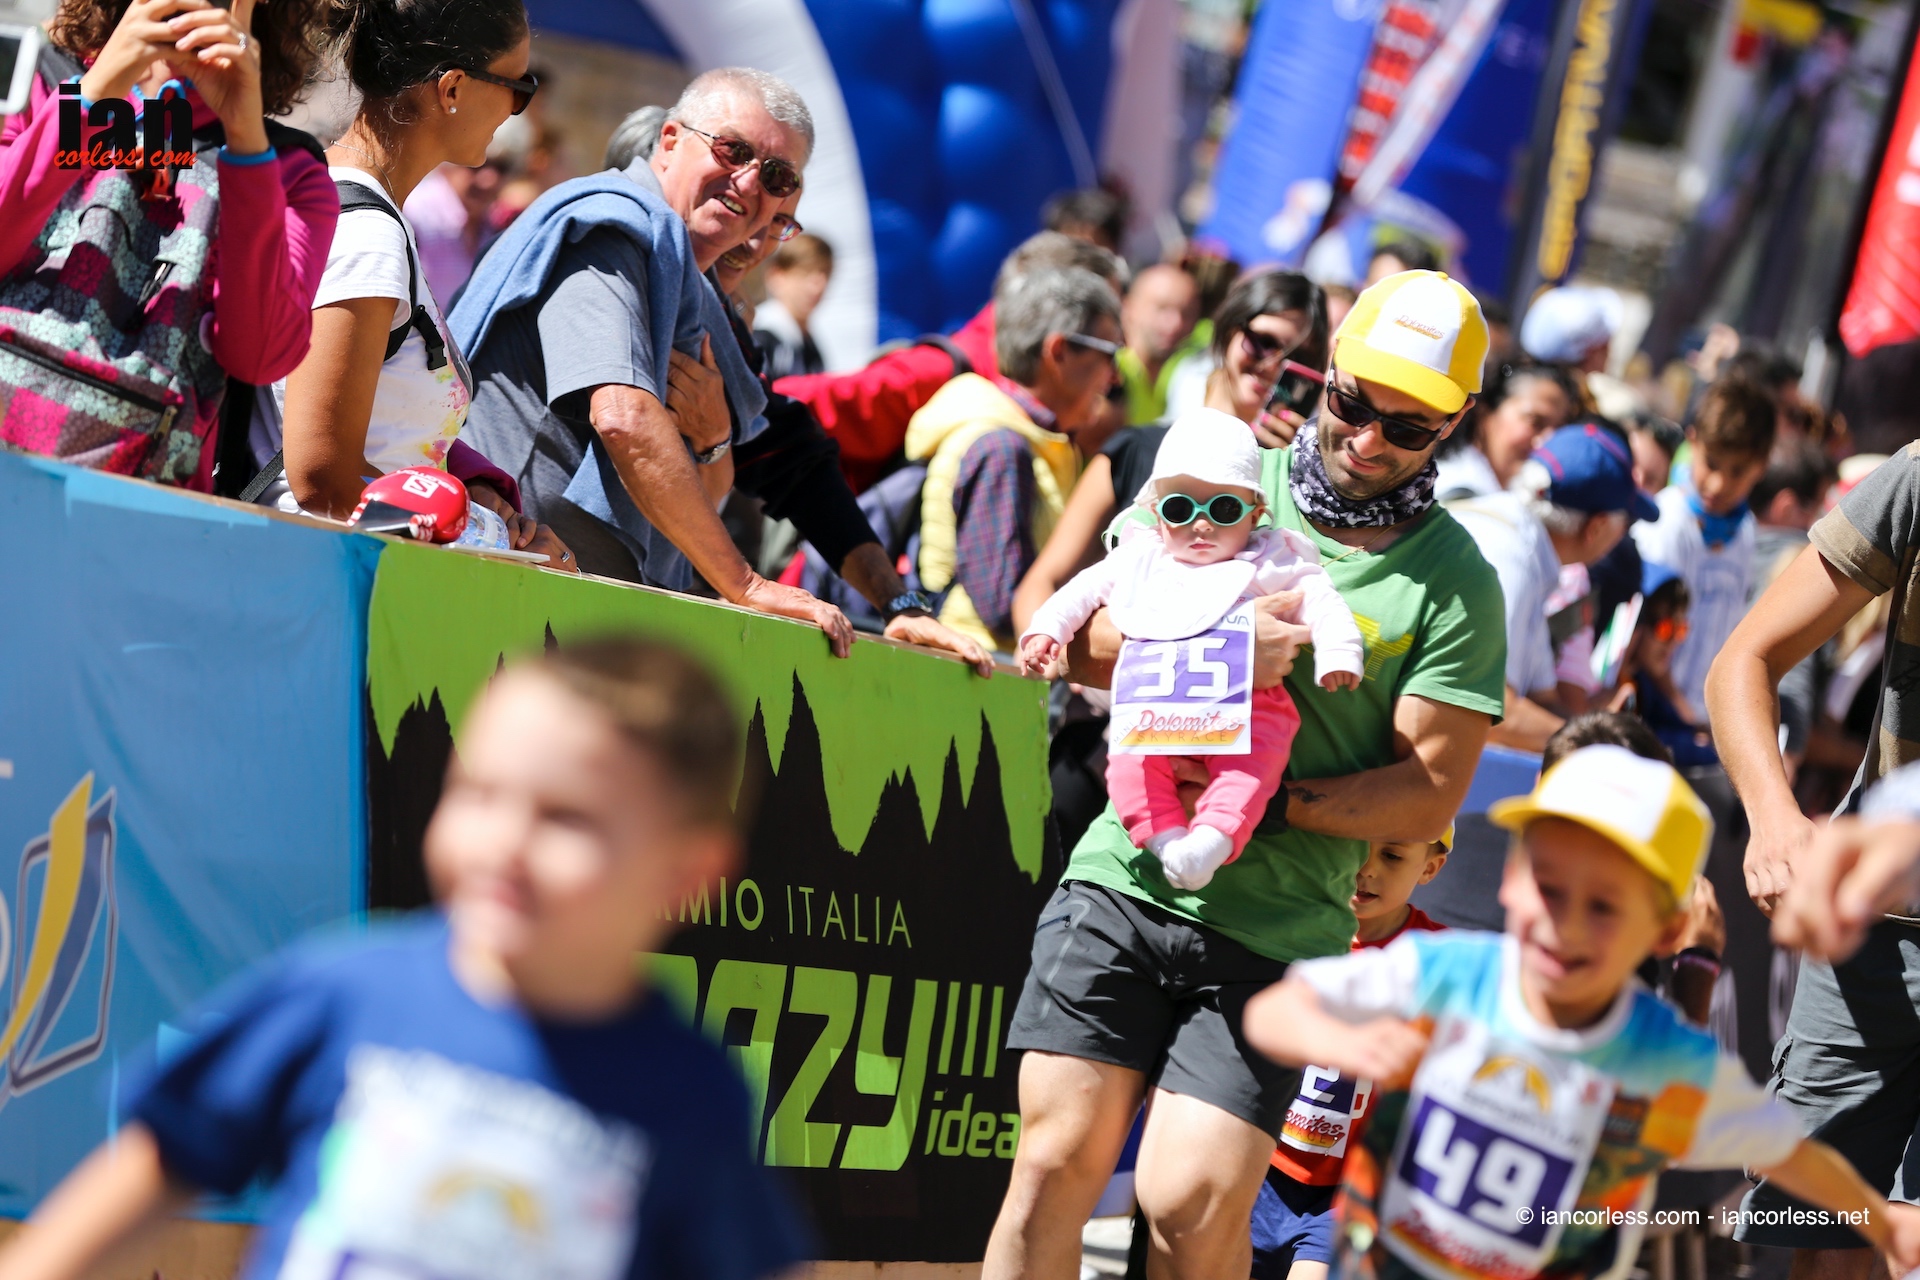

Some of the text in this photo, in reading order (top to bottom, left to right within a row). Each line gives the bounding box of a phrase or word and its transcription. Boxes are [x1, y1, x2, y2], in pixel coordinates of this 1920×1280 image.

[1133, 636, 1231, 698] 35
[1136, 708, 1244, 732] Dolomites
[1136, 730, 1230, 743] SKYRACE
[786, 884, 912, 948] ITALIA
[924, 1091, 1021, 1159] idea
[1412, 1106, 1548, 1234] 49
